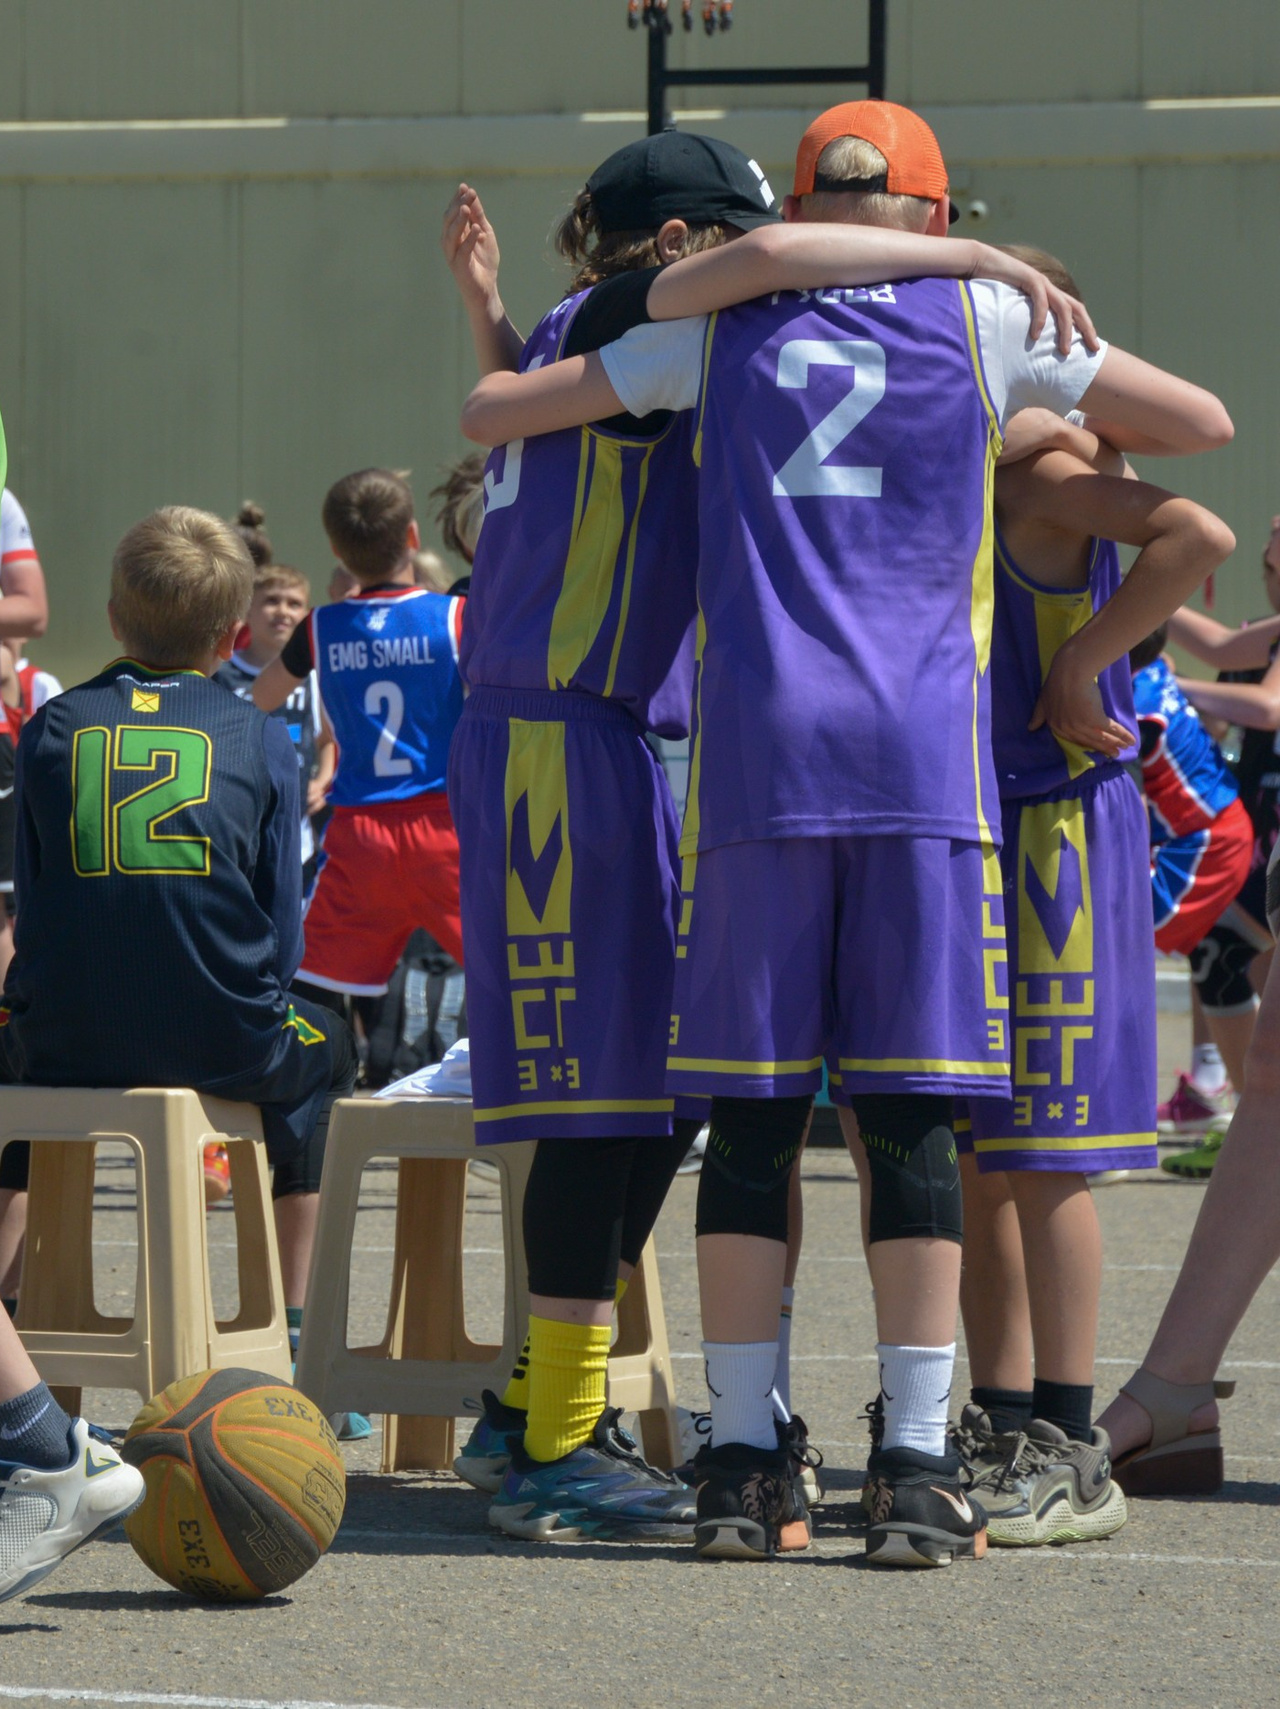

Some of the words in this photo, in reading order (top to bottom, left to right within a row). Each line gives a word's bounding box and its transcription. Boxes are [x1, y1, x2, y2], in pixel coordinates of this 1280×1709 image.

[773, 339, 887, 499] 2
[328, 641, 369, 672] EMG
[372, 635, 436, 668] SMALL
[364, 680, 413, 778] 2
[70, 724, 212, 878] 12
